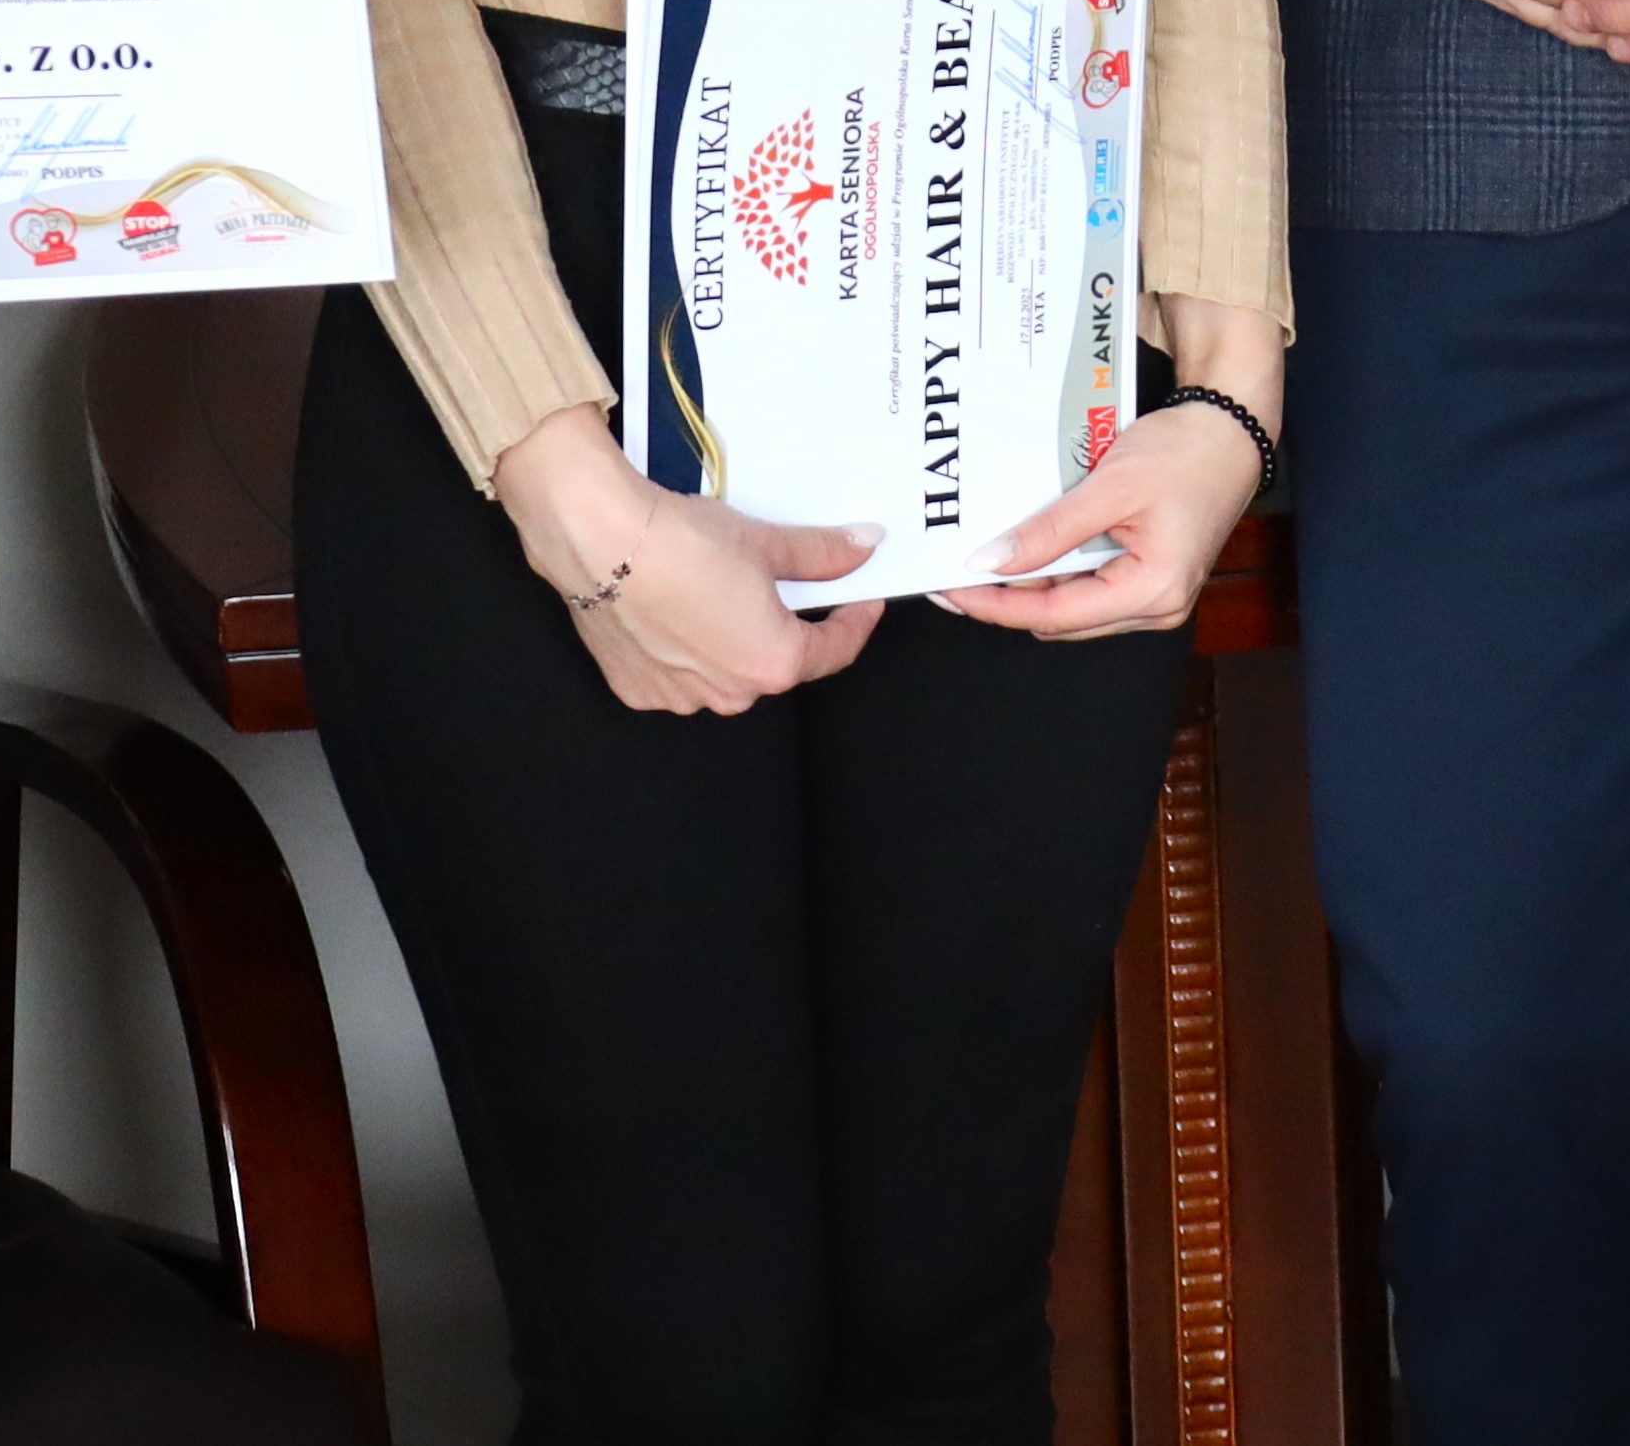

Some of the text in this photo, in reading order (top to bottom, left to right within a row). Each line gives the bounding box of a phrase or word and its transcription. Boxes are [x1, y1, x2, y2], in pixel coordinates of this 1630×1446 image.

[30, 46, 53, 72] z
[71, 42, 153, 71] o.o.
[900, 22, 912, 54] Karta
[1048, 25, 1062, 80] PODPIS
[894, 59, 909, 138] Ogólnopolska
[929, 108, 968, 149] &
[41, 165, 104, 180] PODPIS
[839, 86, 865, 299] KARTA SENIORA
[863, 120, 880, 259] OGÓLNOPOLSKA
[892, 142, 905, 204] Programie
[1095, 140, 1108, 192] MIRS
[125, 215, 171, 230] STOP
[693, 76, 731, 330] CERTYFIKAT
[925, 167, 964, 317] HAIR
[890, 261, 903, 352] poświadczający
[1020, 286, 1032, 343] 17.12.2025
[1034, 290, 1045, 333] DATA
[1090, 270, 1115, 388] MANKO
[889, 356, 903, 413] Certyfikat
[924, 334, 961, 530] HAPPY
